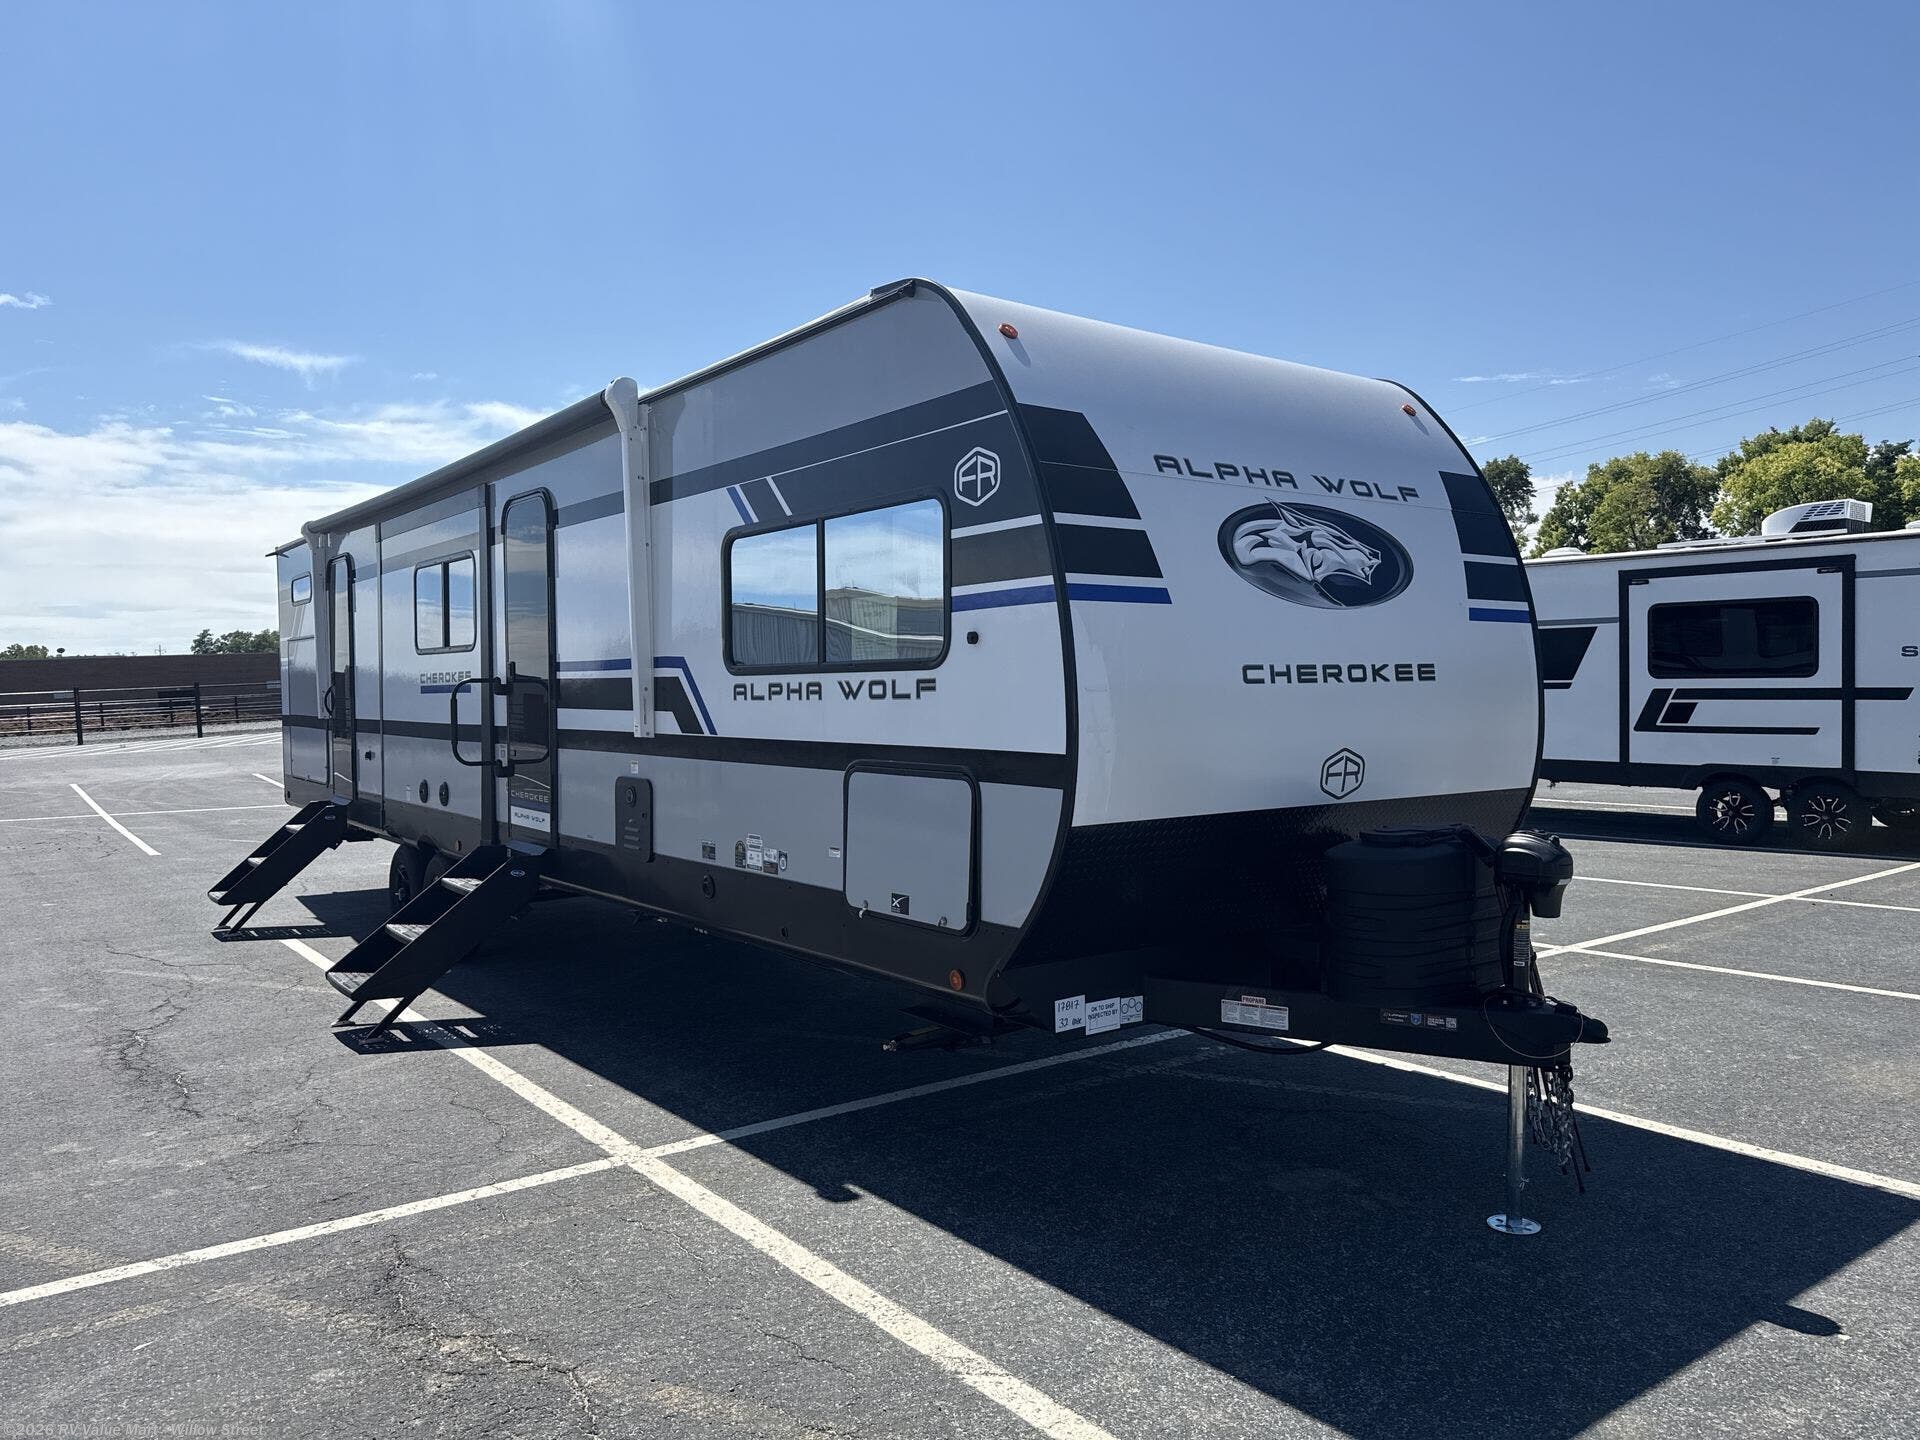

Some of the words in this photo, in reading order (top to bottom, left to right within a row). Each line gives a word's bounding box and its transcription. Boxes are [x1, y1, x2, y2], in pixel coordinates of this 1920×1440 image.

[1153, 454, 1299, 489] ALPHA
[1312, 474, 1420, 502] WOLF
[1242, 663, 1436, 685] CHEROKEE
[733, 681, 822, 701] ALPHA
[837, 677, 937, 700] WOLF
[511, 791, 549, 803] CHEROKEE
[1242, 996, 1265, 1005] PROPANE
[1088, 1011, 1111, 1020] INSPECTED
